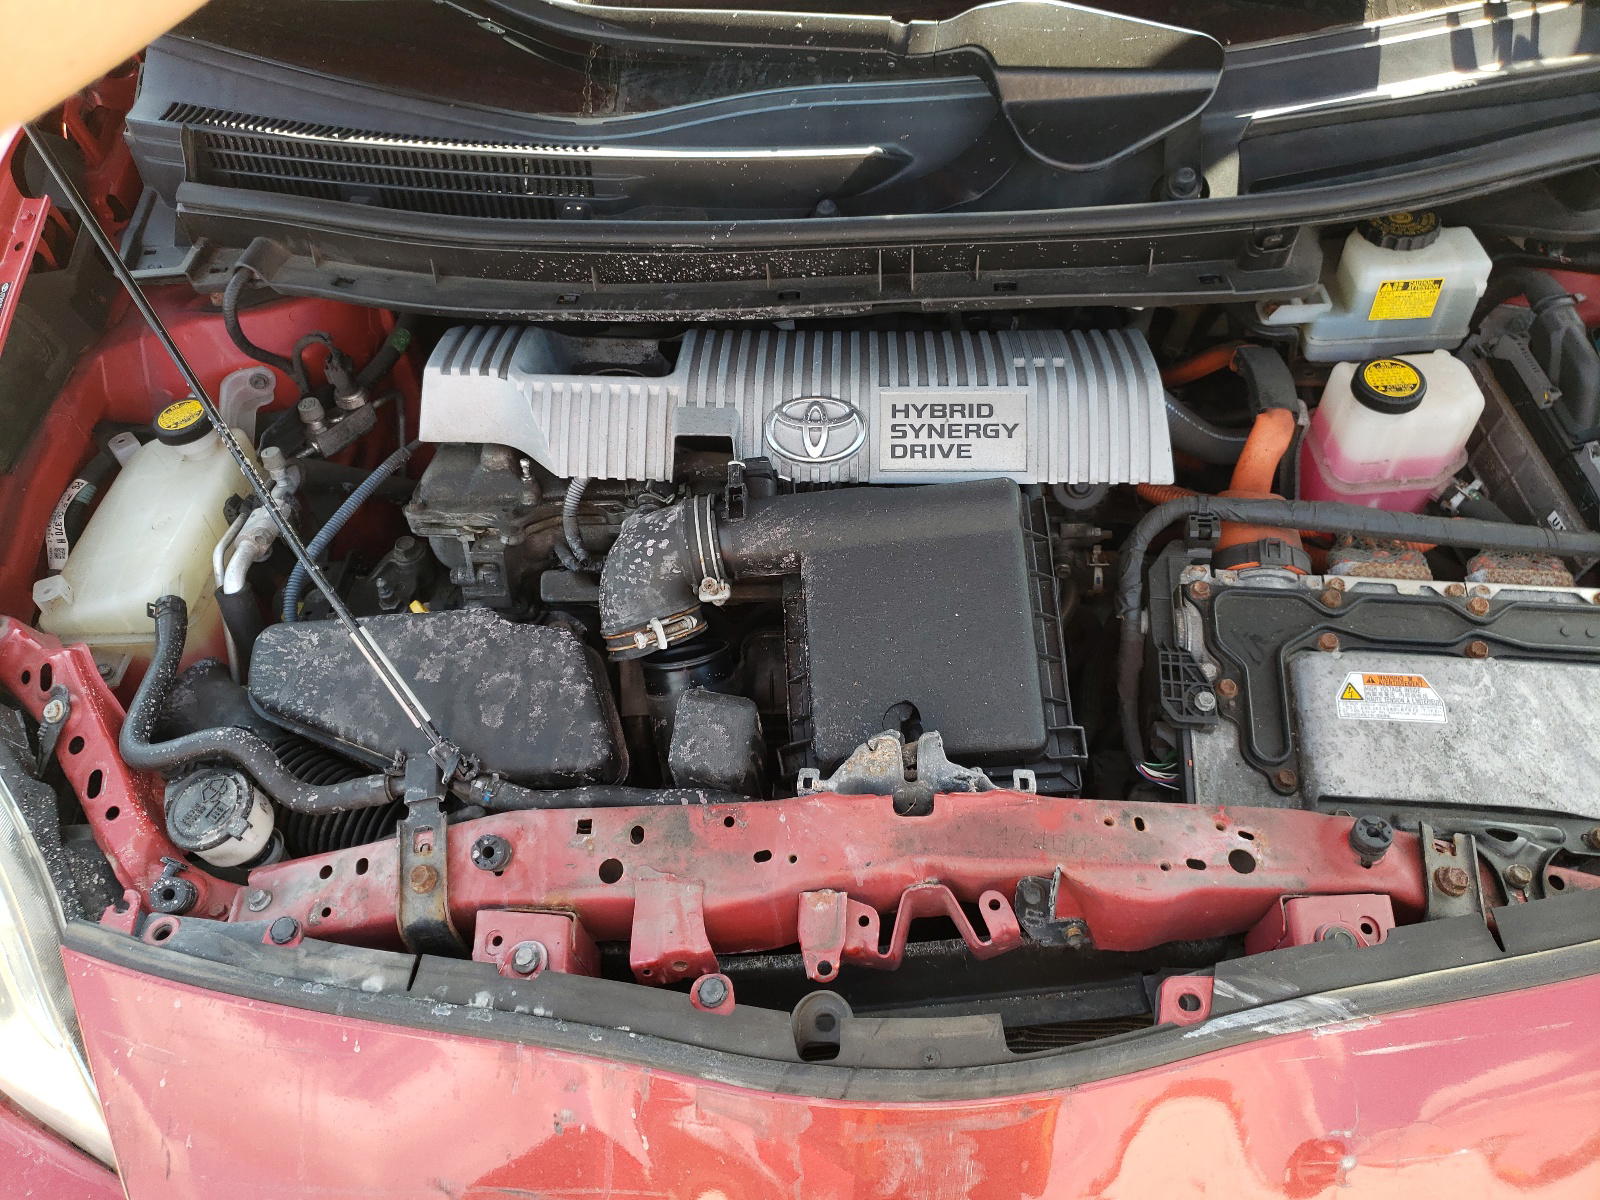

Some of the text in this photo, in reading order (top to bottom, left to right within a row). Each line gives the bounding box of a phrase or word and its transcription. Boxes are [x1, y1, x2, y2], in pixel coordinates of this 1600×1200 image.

[891, 403, 994, 419] HYBRID
[890, 423, 1019, 439] SYNERGY
[890, 443, 972, 459] DRIVE
